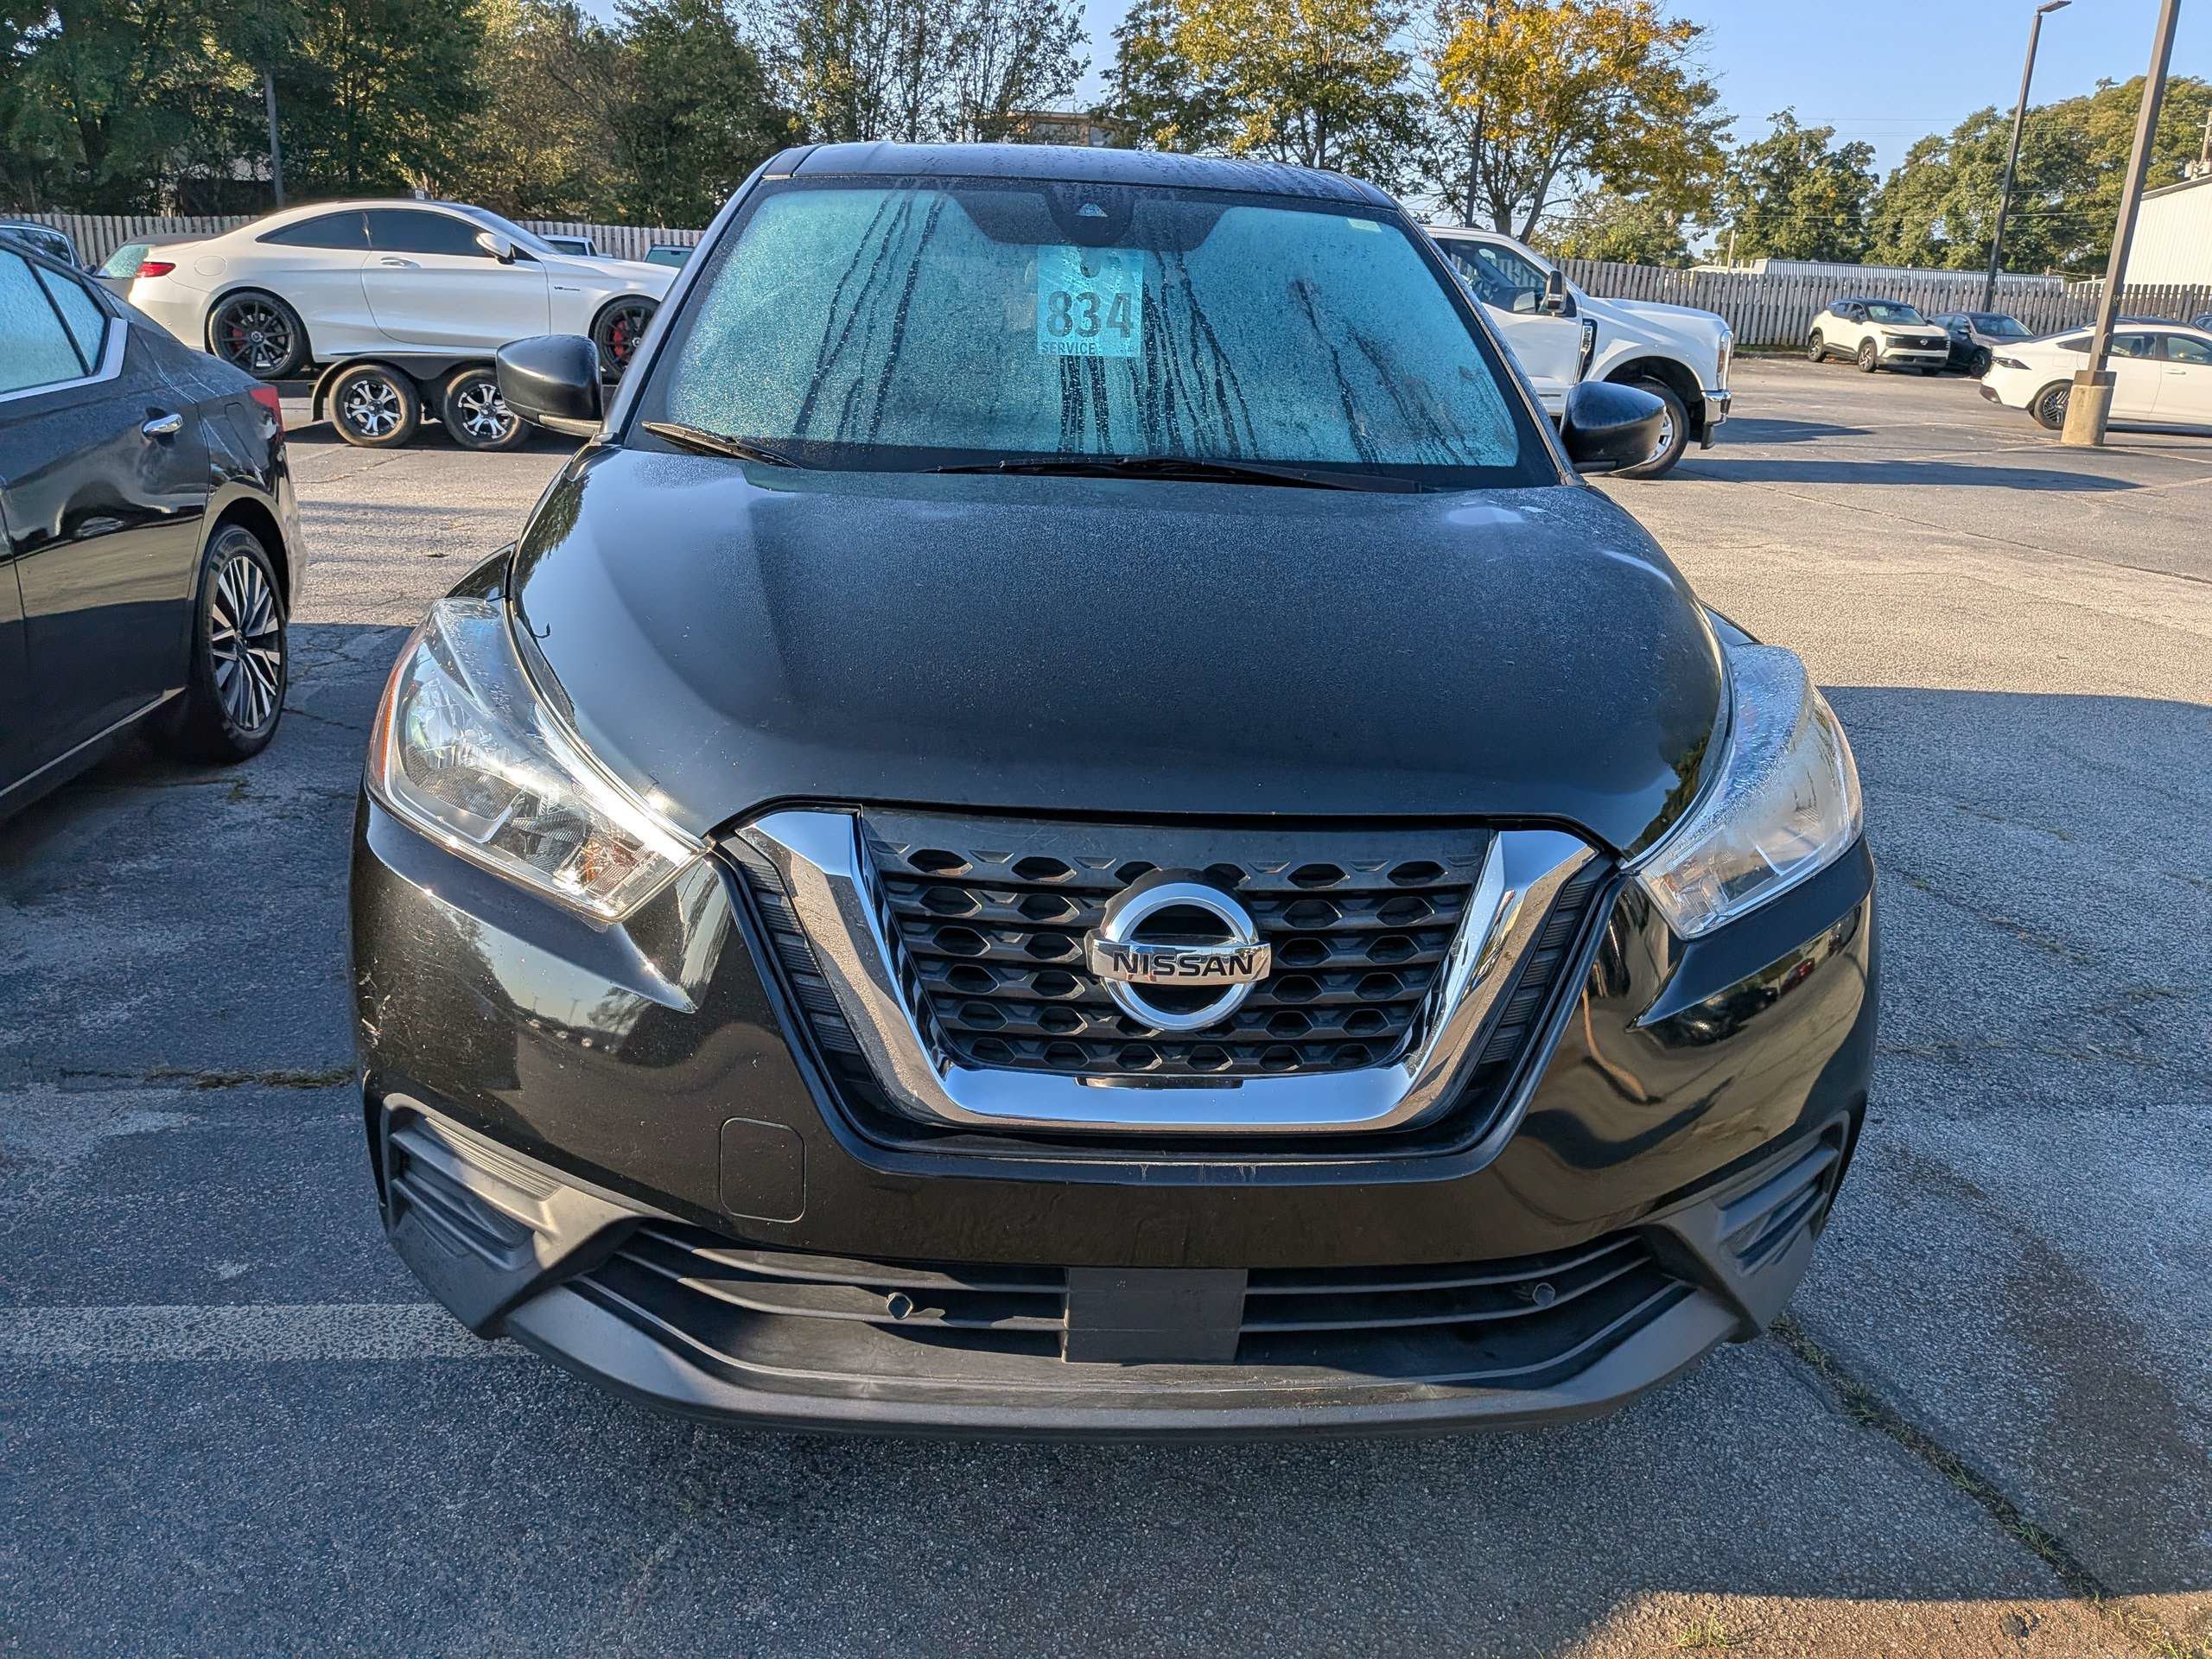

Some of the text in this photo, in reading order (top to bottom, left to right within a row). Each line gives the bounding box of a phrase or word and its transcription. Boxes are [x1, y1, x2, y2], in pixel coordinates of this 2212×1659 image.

[1046, 290, 1134, 338] 834
[1040, 341, 1096, 354] SERVICE
[1113, 951, 1253, 976] NISSAN
